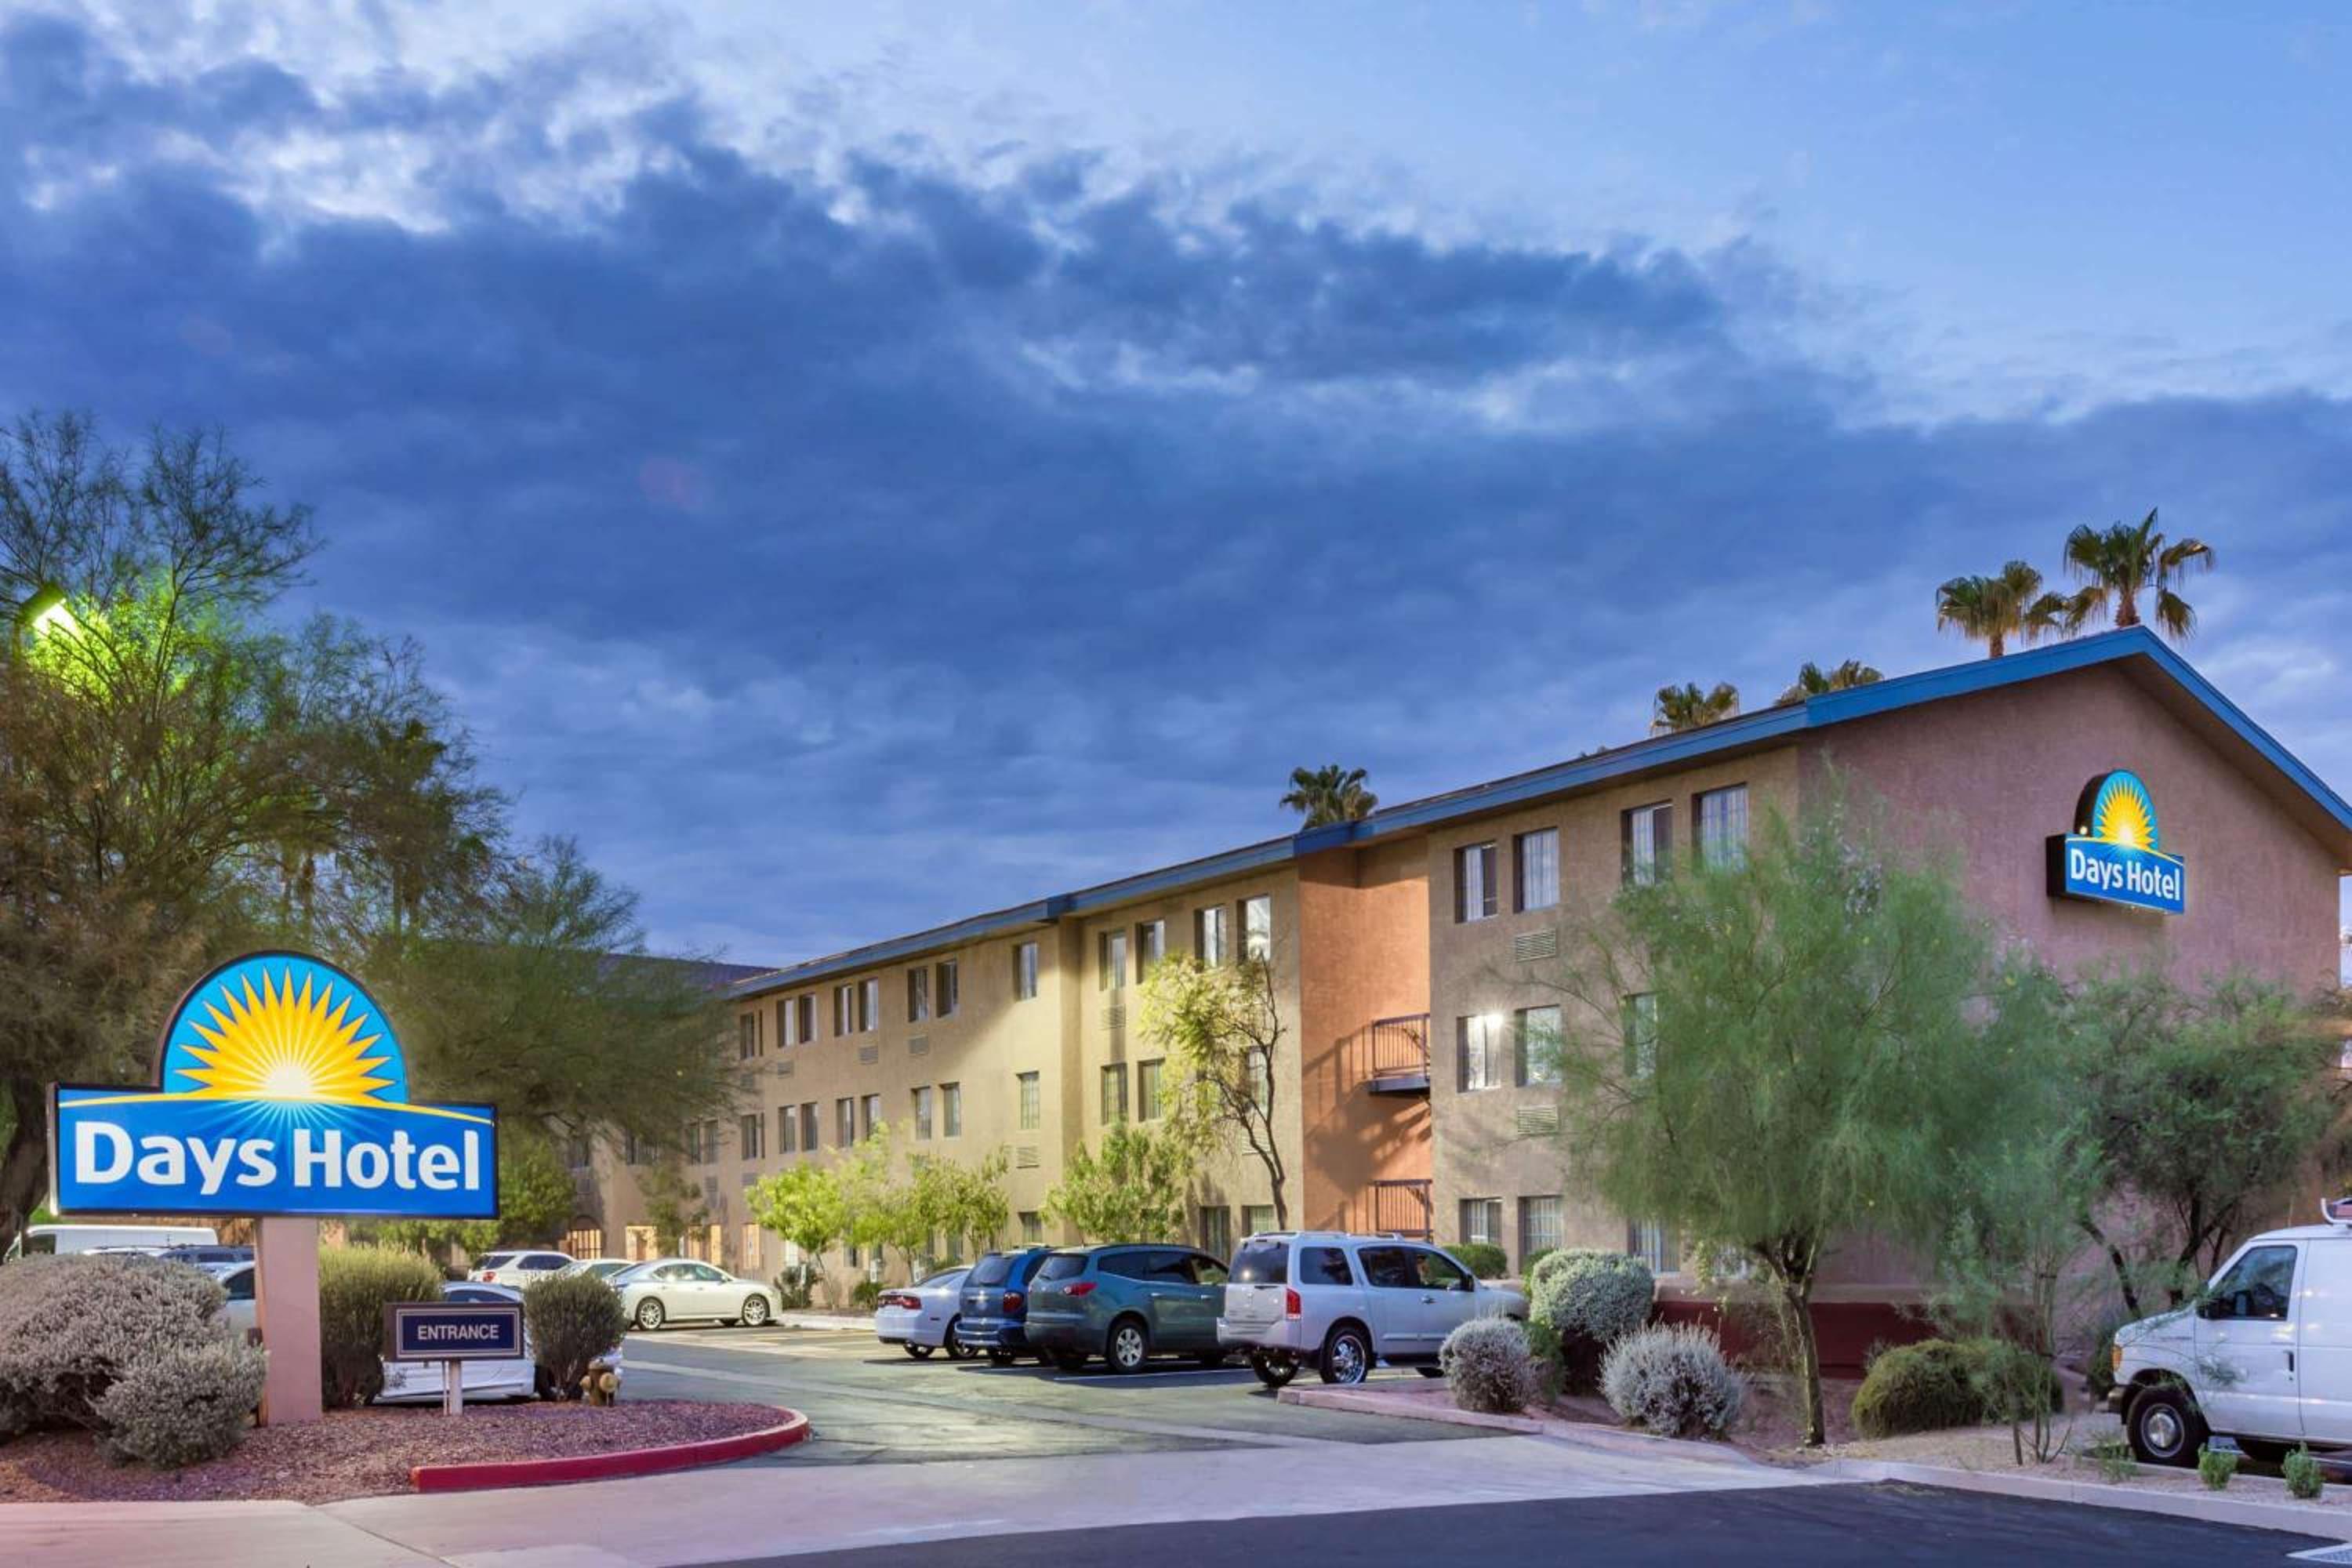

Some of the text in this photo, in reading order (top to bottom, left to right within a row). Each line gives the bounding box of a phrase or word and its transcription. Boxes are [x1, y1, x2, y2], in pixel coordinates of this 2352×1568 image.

[2071, 848, 2180, 901] Days Hotel
[74, 1120, 479, 1196] Days Hotel
[418, 1324, 499, 1341] ENTRANCE
